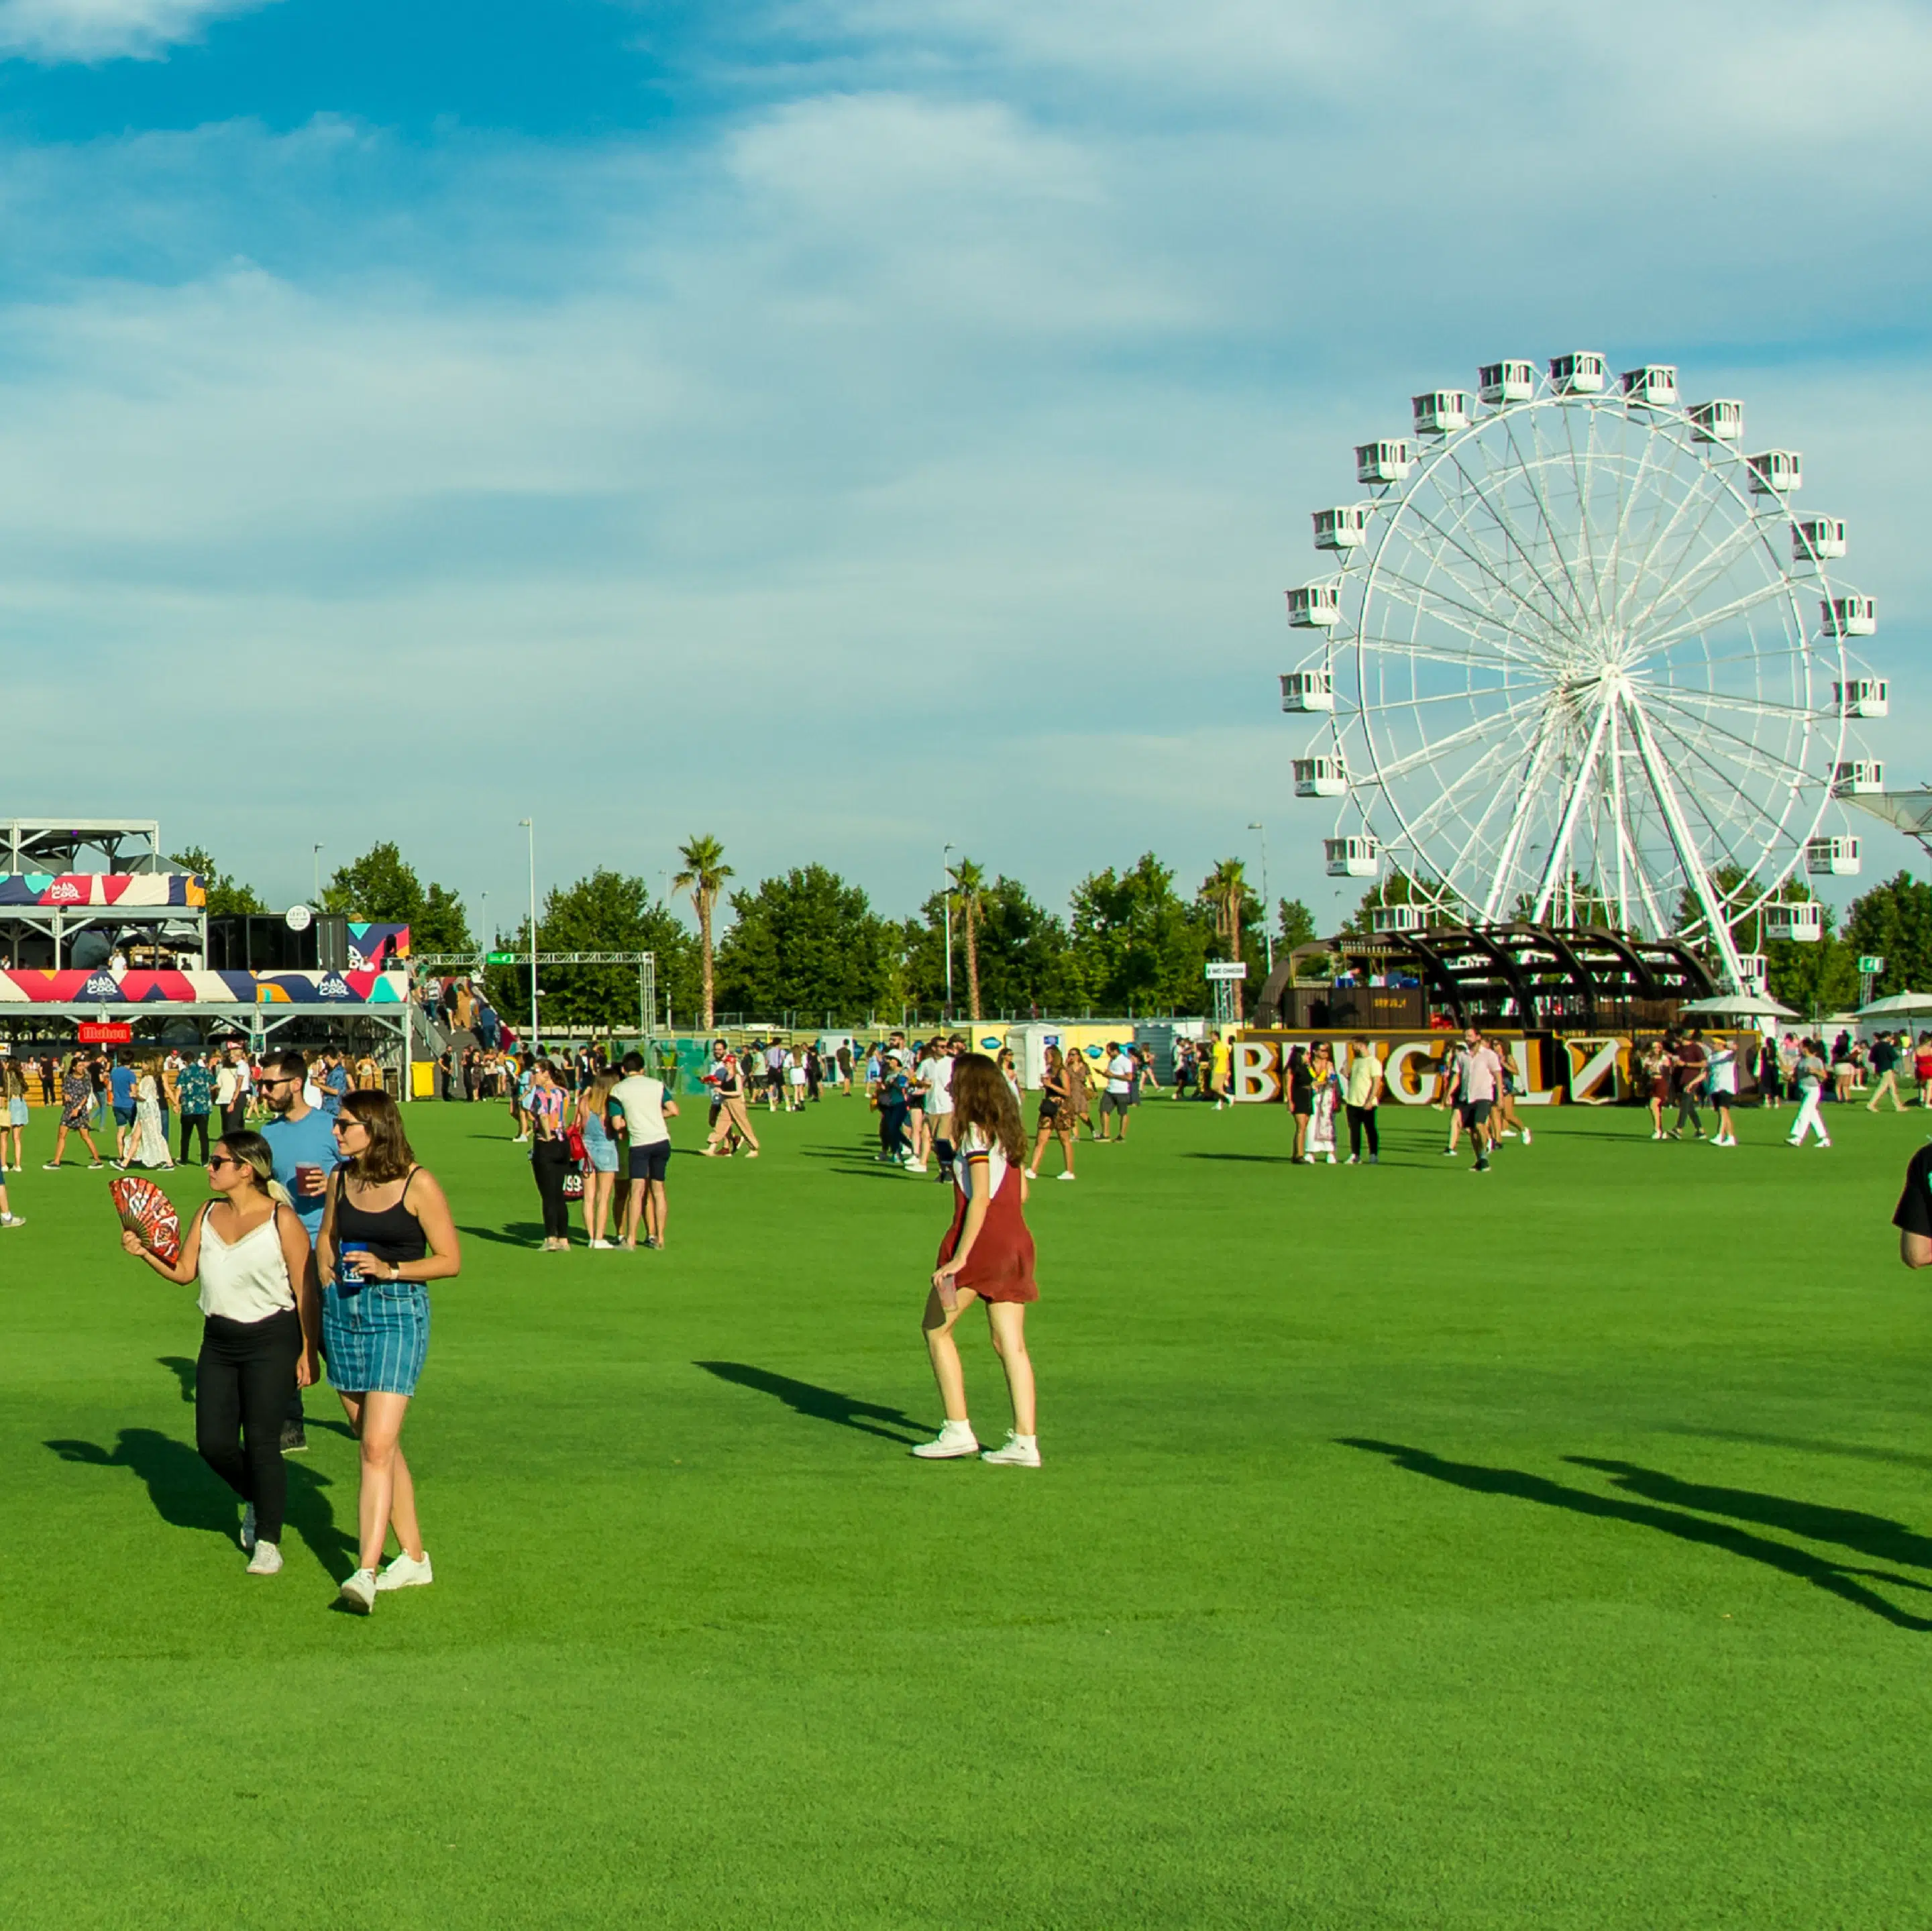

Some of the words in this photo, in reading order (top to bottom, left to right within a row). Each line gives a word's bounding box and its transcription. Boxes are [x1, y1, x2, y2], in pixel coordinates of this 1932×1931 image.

[52, 889, 80, 899] COOL
[87, 984, 118, 994] COOL
[319, 986, 350, 996] COOL
[1233, 1040, 1562, 1105] BGL
